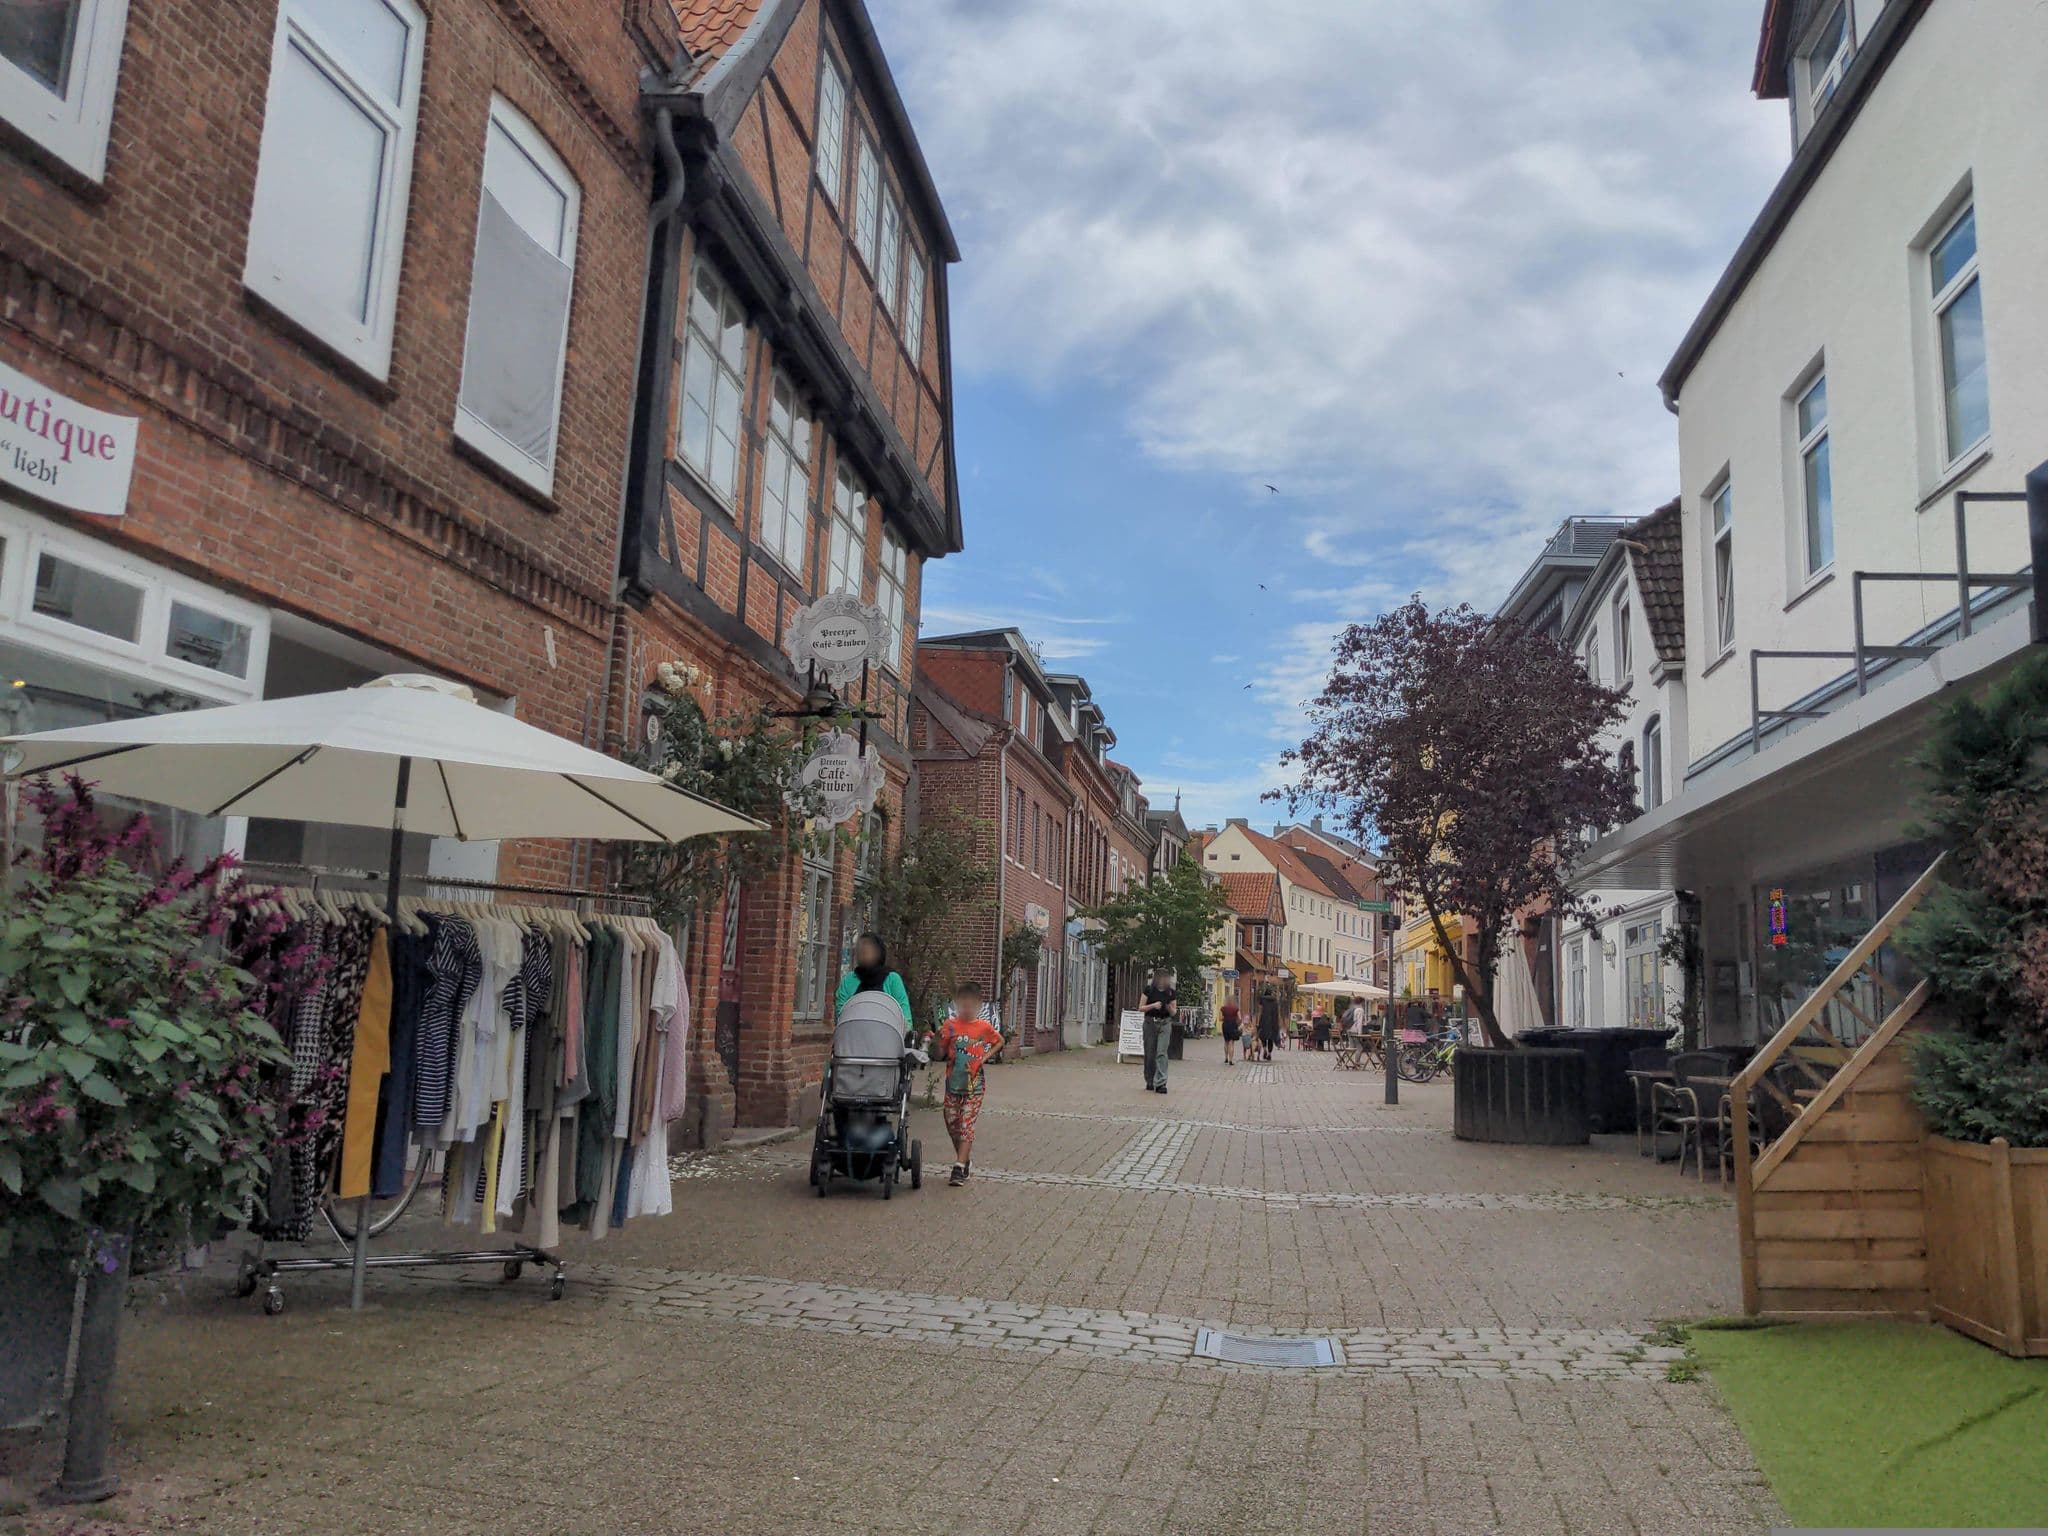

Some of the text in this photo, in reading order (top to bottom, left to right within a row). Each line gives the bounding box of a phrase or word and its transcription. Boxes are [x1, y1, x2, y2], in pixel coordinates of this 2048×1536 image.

[0, 388, 116, 464] utique
[820, 629, 857, 638] Preetzer
[812, 639, 866, 649] Café-Stuben
[820, 758, 848, 766] Preetzer
[818, 767, 850, 779] Café-
[821, 780, 854, 792] tuben
